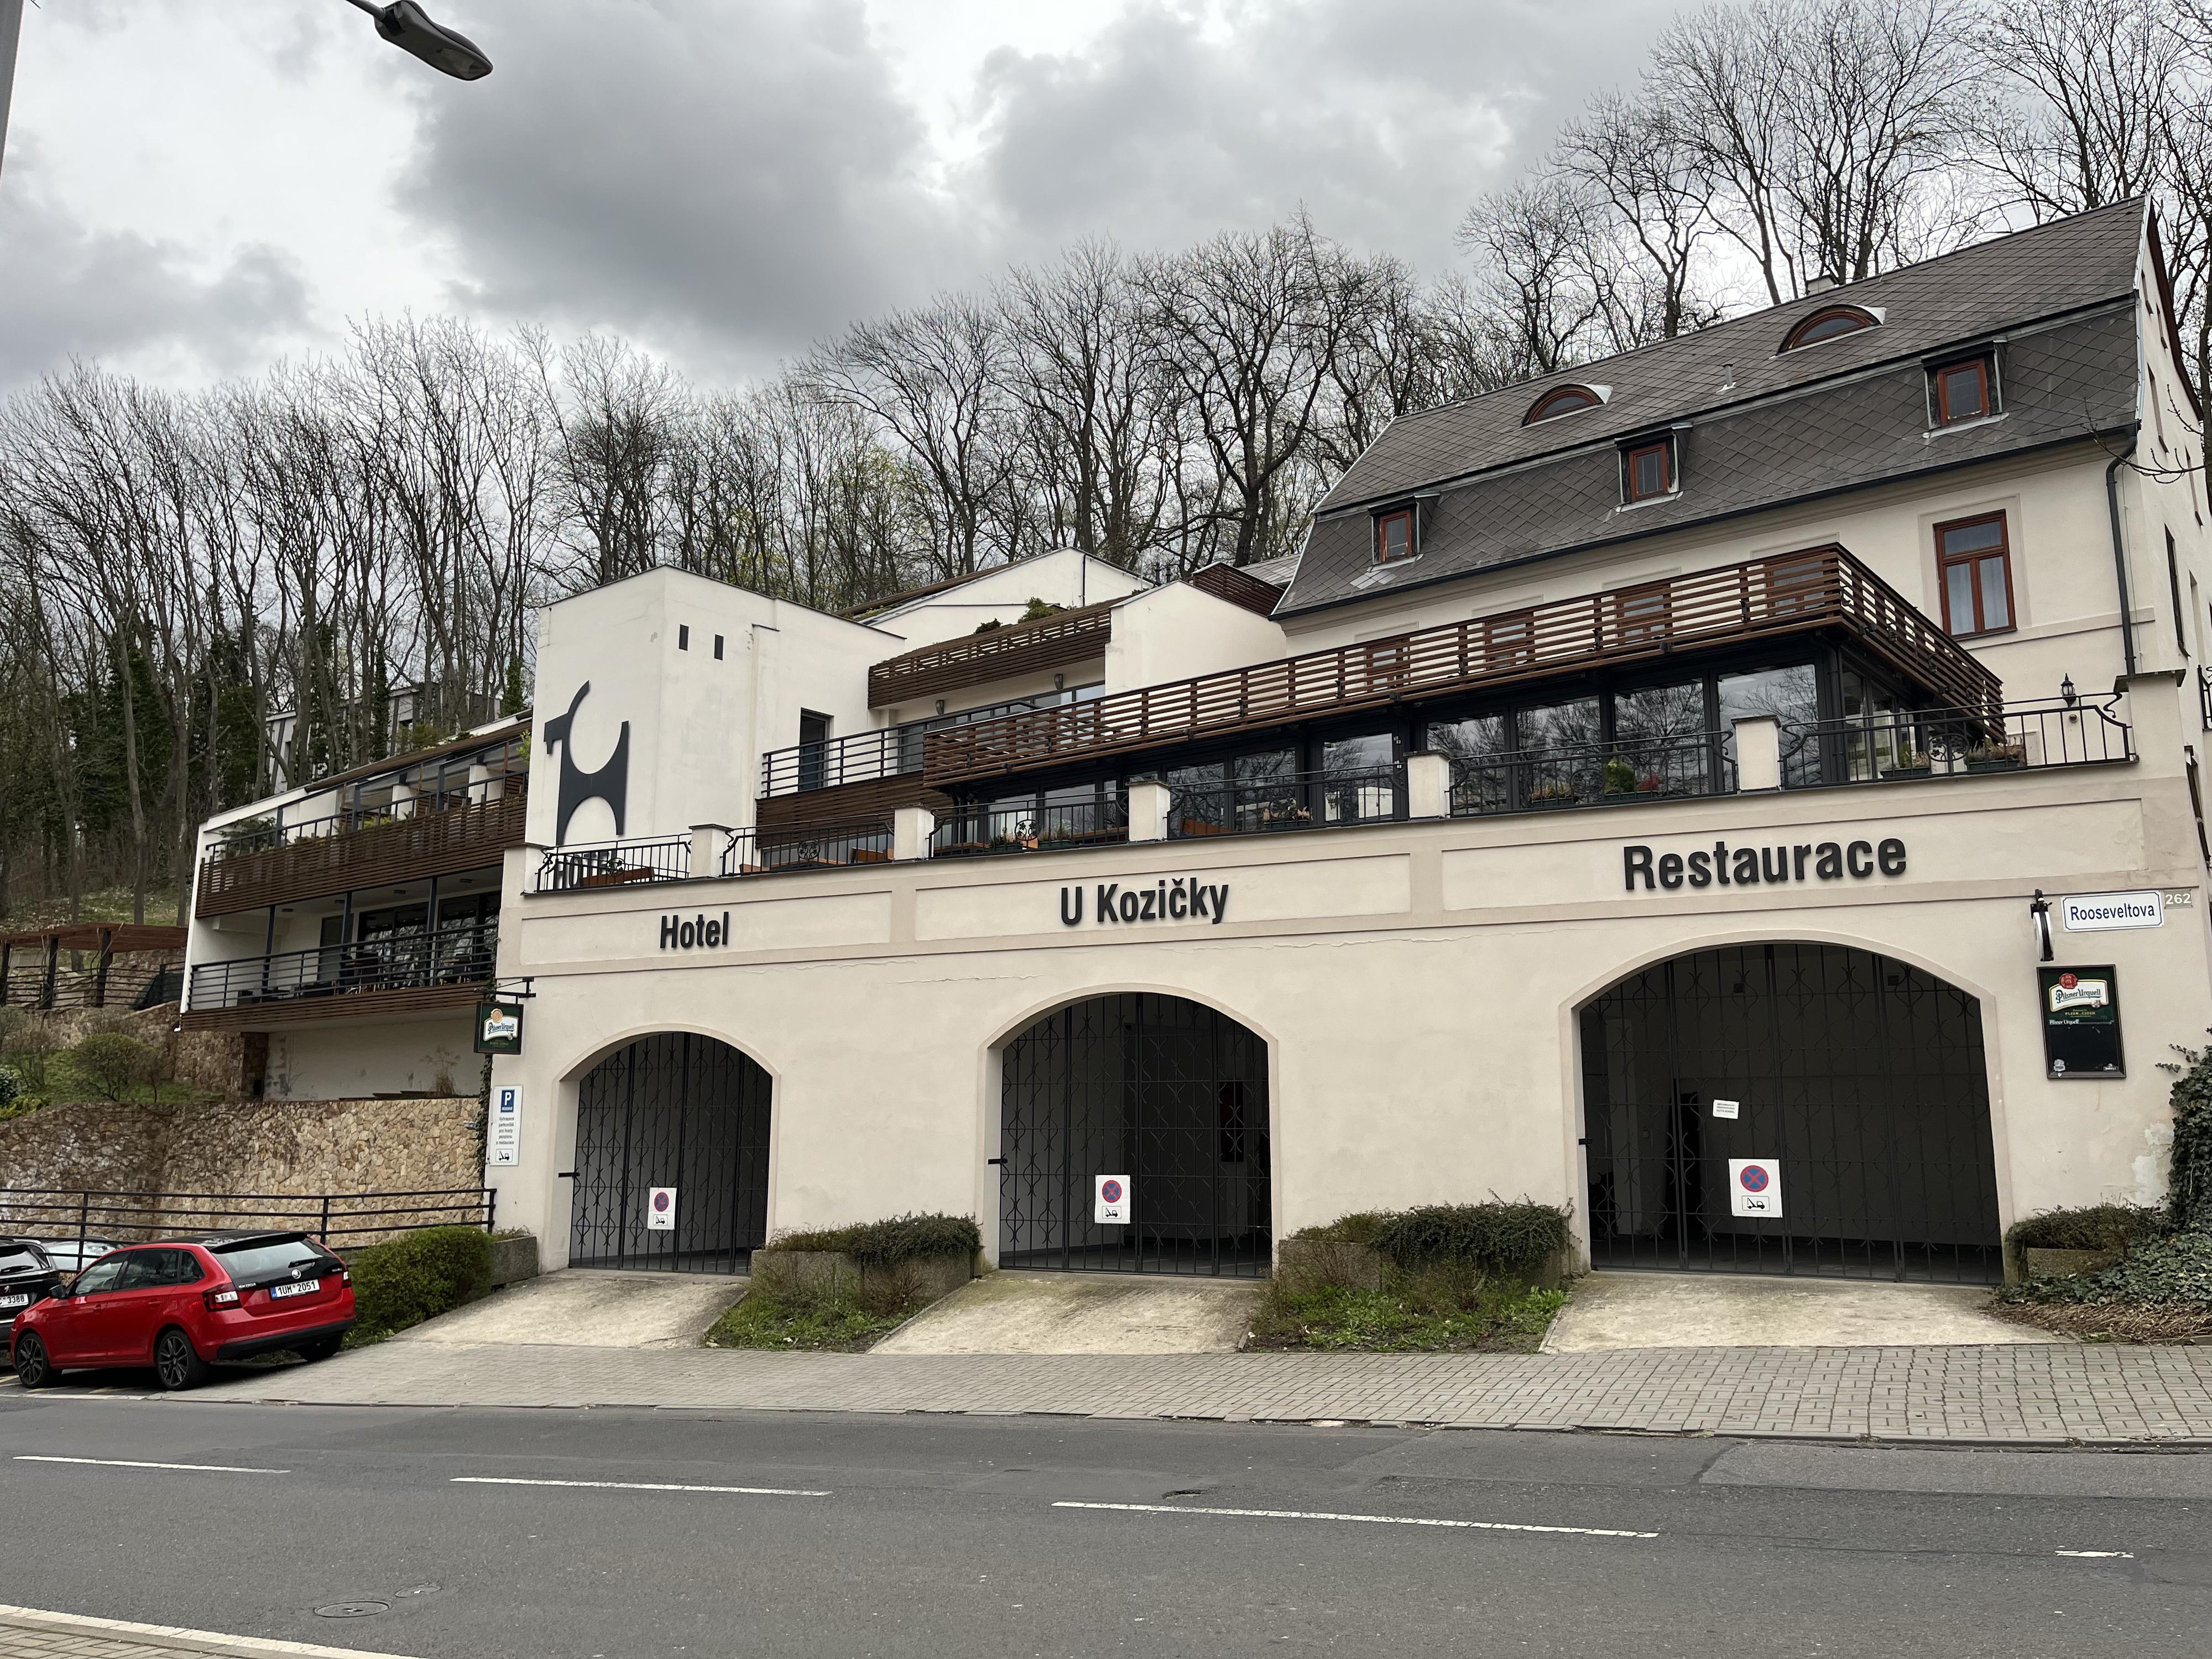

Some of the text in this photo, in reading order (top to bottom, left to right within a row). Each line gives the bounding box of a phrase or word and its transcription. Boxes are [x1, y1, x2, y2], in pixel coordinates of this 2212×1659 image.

[1624, 837, 1907, 890] Restaurace
[1061, 877, 1229, 925] U Kozičky
[2164, 893, 2192, 905] 262
[2070, 903, 2155, 921] Rooseveltova
[660, 911, 729, 948] Hotel
[2056, 988, 2101, 1004] Pilsner Urquell
[488, 1022, 502, 1035] Pilsner
[504, 1092, 512, 1106] P
[278, 1285, 292, 1295] 1UM
[297, 1281, 315, 1292] 2051
[7, 1295, 25, 1304] 3388
